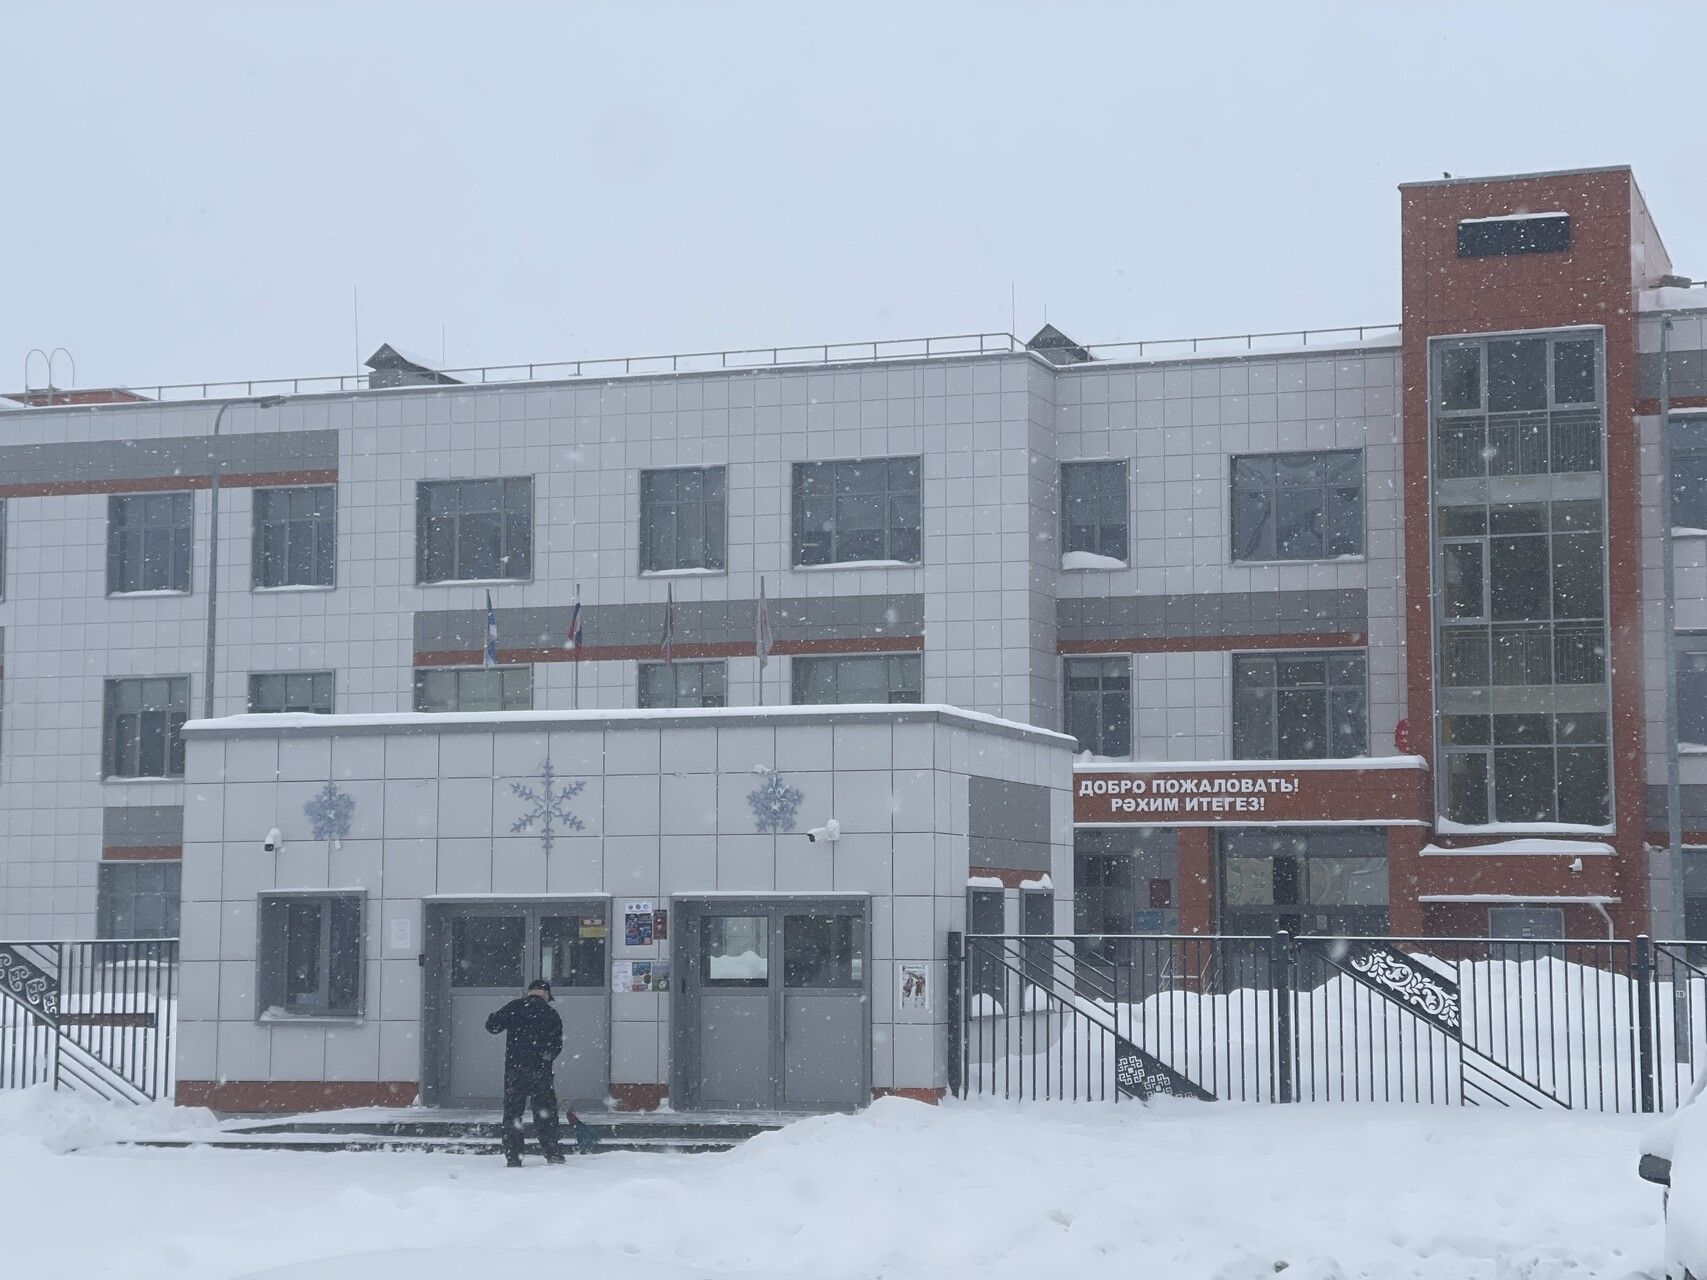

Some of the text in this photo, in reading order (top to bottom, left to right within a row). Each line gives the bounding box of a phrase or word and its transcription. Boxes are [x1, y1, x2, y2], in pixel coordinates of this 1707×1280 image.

[1079, 778, 1299, 796] ДОБРО ПОЖАЛОВАТЬ!
[1111, 797, 1265, 812] РӘХИМ ИТЕГЕЗ!
